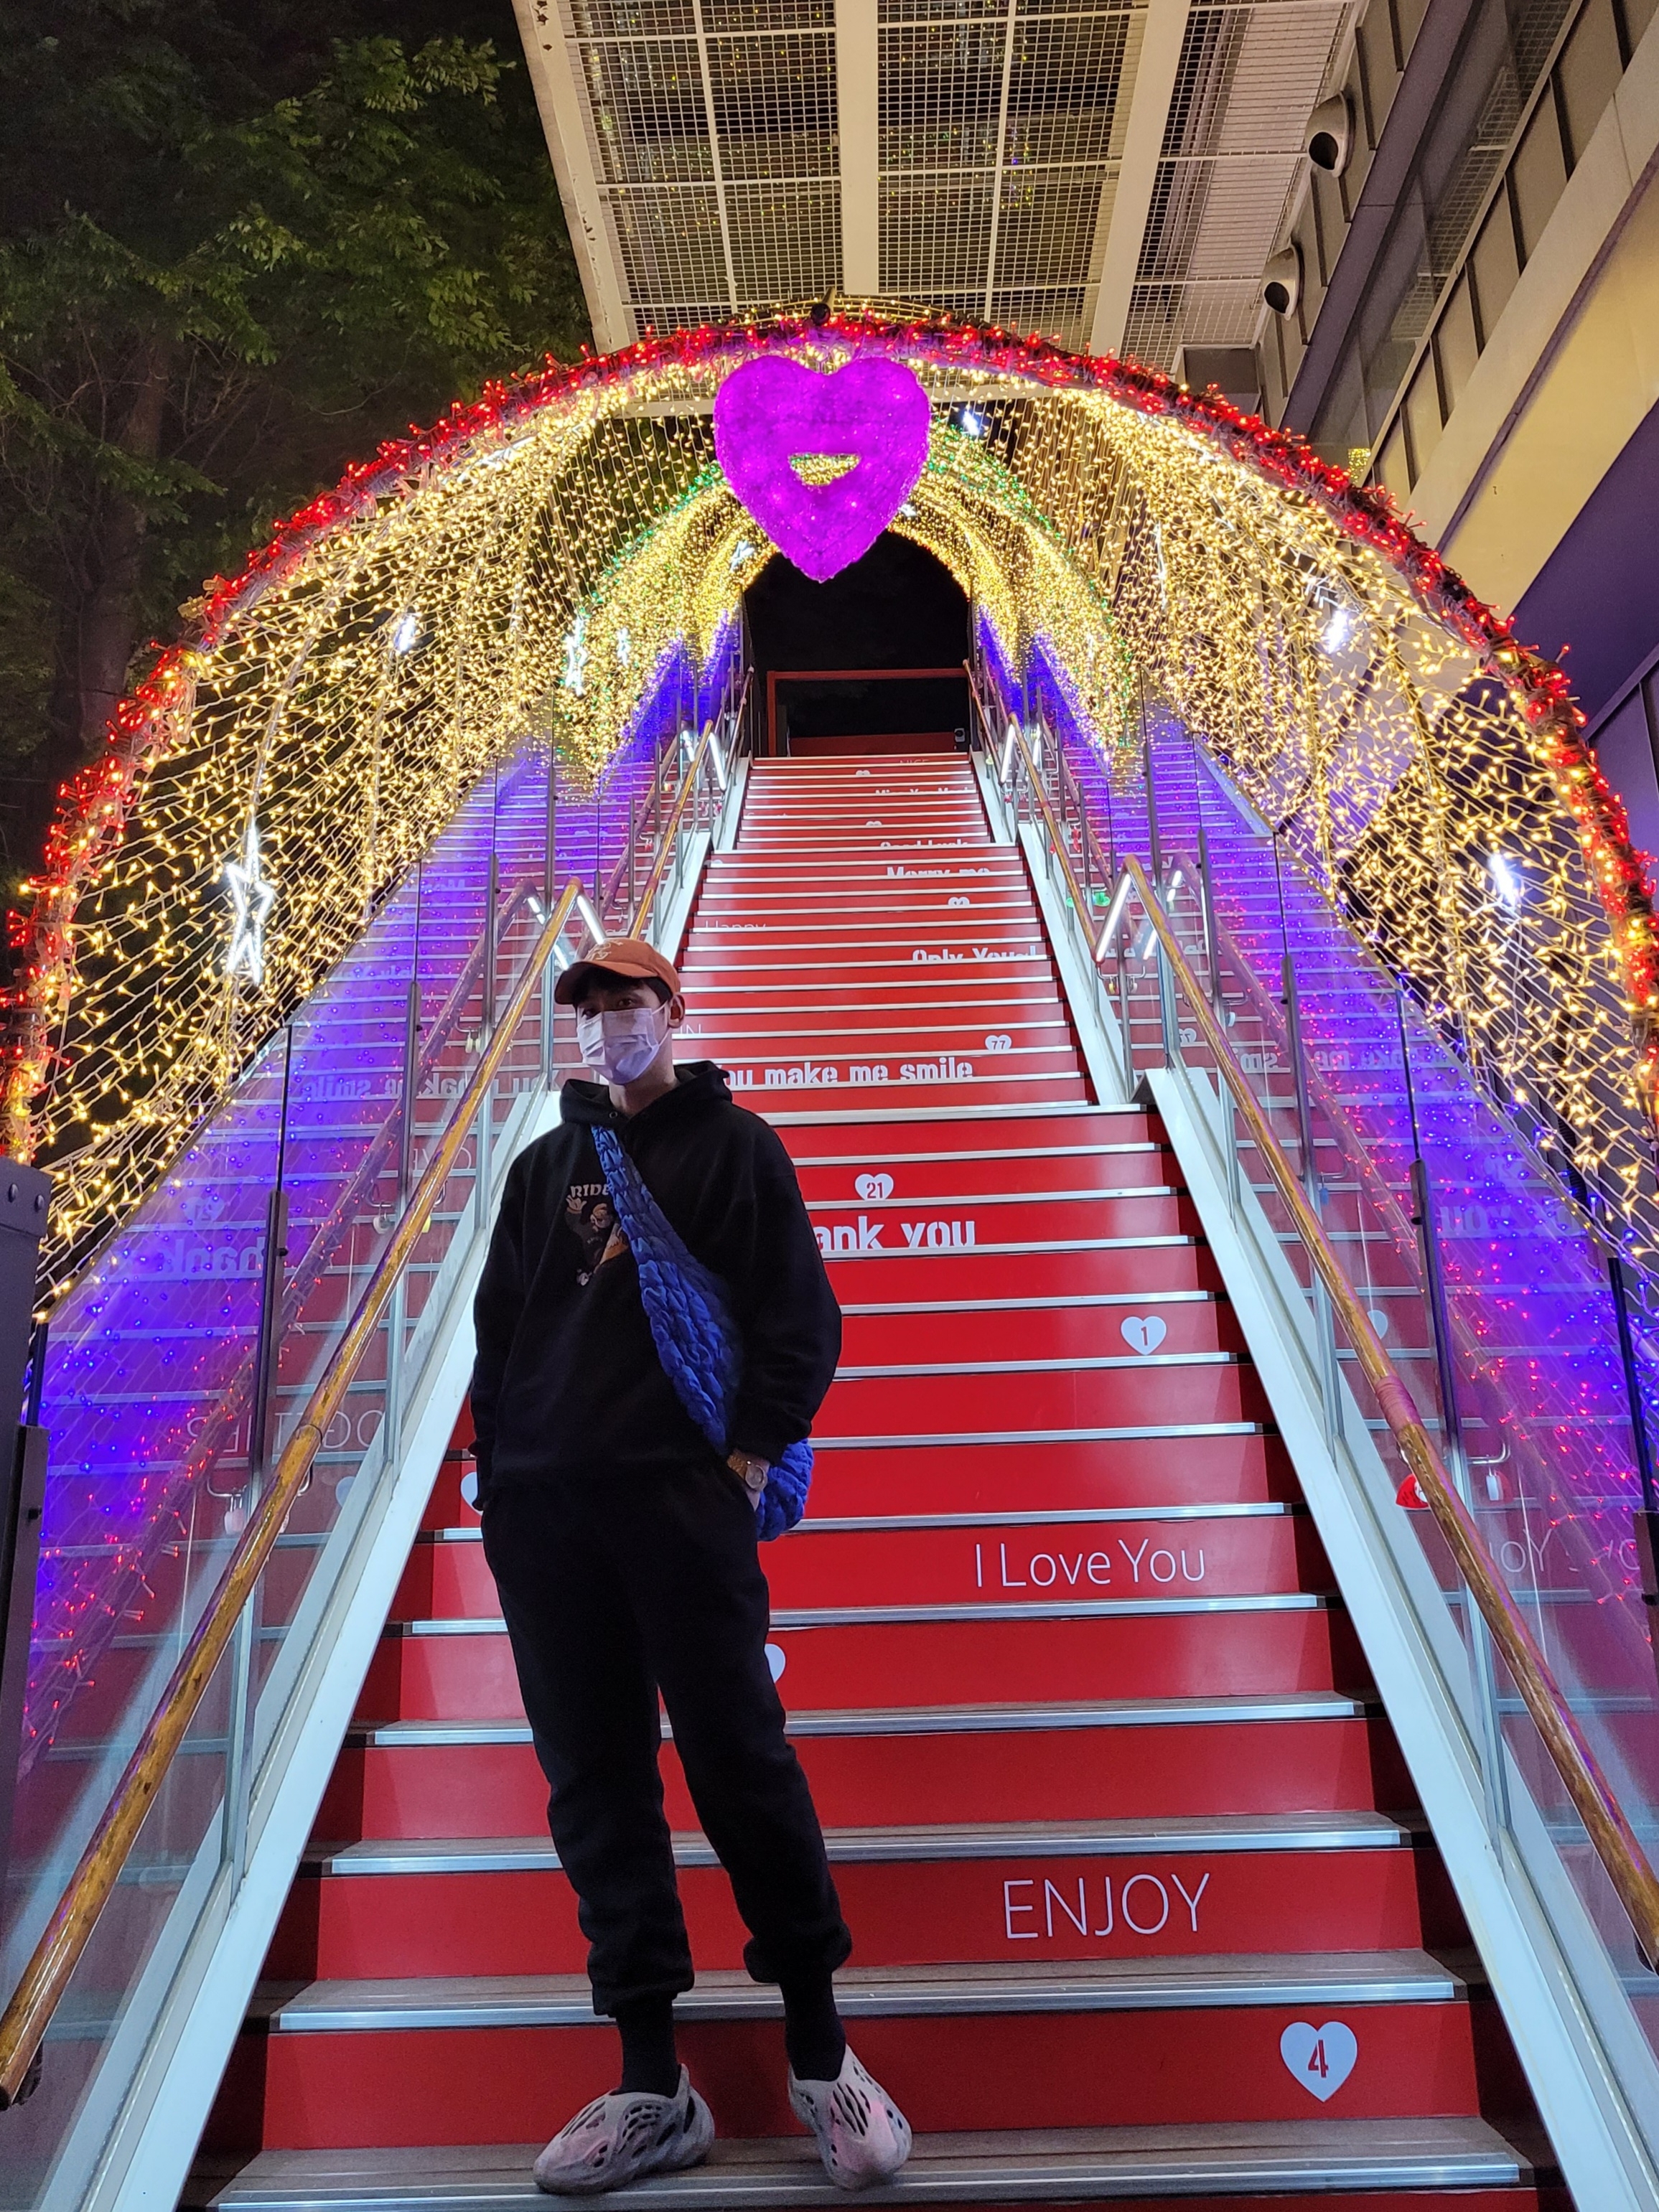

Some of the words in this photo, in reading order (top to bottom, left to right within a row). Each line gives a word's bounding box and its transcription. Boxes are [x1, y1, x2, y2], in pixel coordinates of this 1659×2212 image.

[765, 1062, 838, 1085] make
[849, 1064, 888, 1082] me
[900, 1057, 973, 1081] smile
[866, 1182, 884, 1199] 21
[813, 1216, 885, 1250] ank
[901, 1220, 976, 1249] you
[976, 1543, 982, 1588] I
[1000, 1542, 1111, 1587] Love
[1117, 1538, 1206, 1583] You
[1004, 1872, 1210, 1939] ENJOY
[1307, 2038, 1329, 2079] 4
